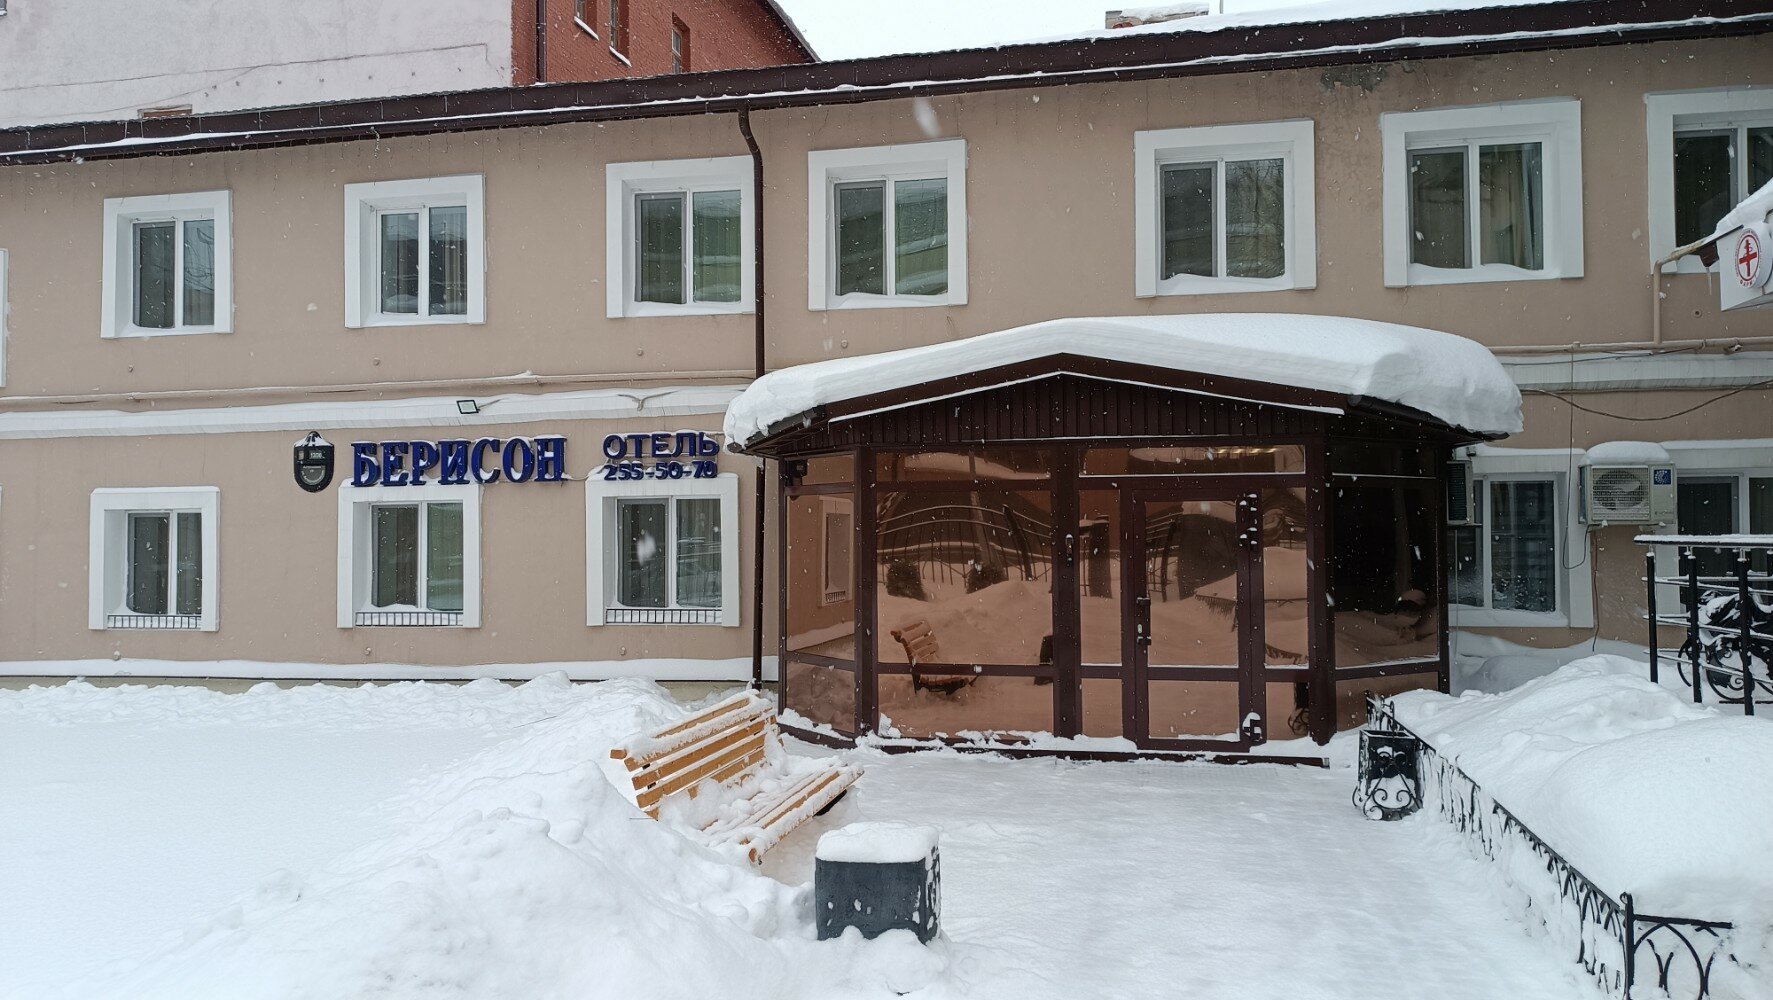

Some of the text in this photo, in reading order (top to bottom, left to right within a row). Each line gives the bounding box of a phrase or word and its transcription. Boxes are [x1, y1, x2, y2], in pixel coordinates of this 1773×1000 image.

[602, 431, 720, 460] ОТЕЛЬ
[351, 438, 568, 487] БЕРИСОН
[603, 460, 718, 481] 255-50-70
